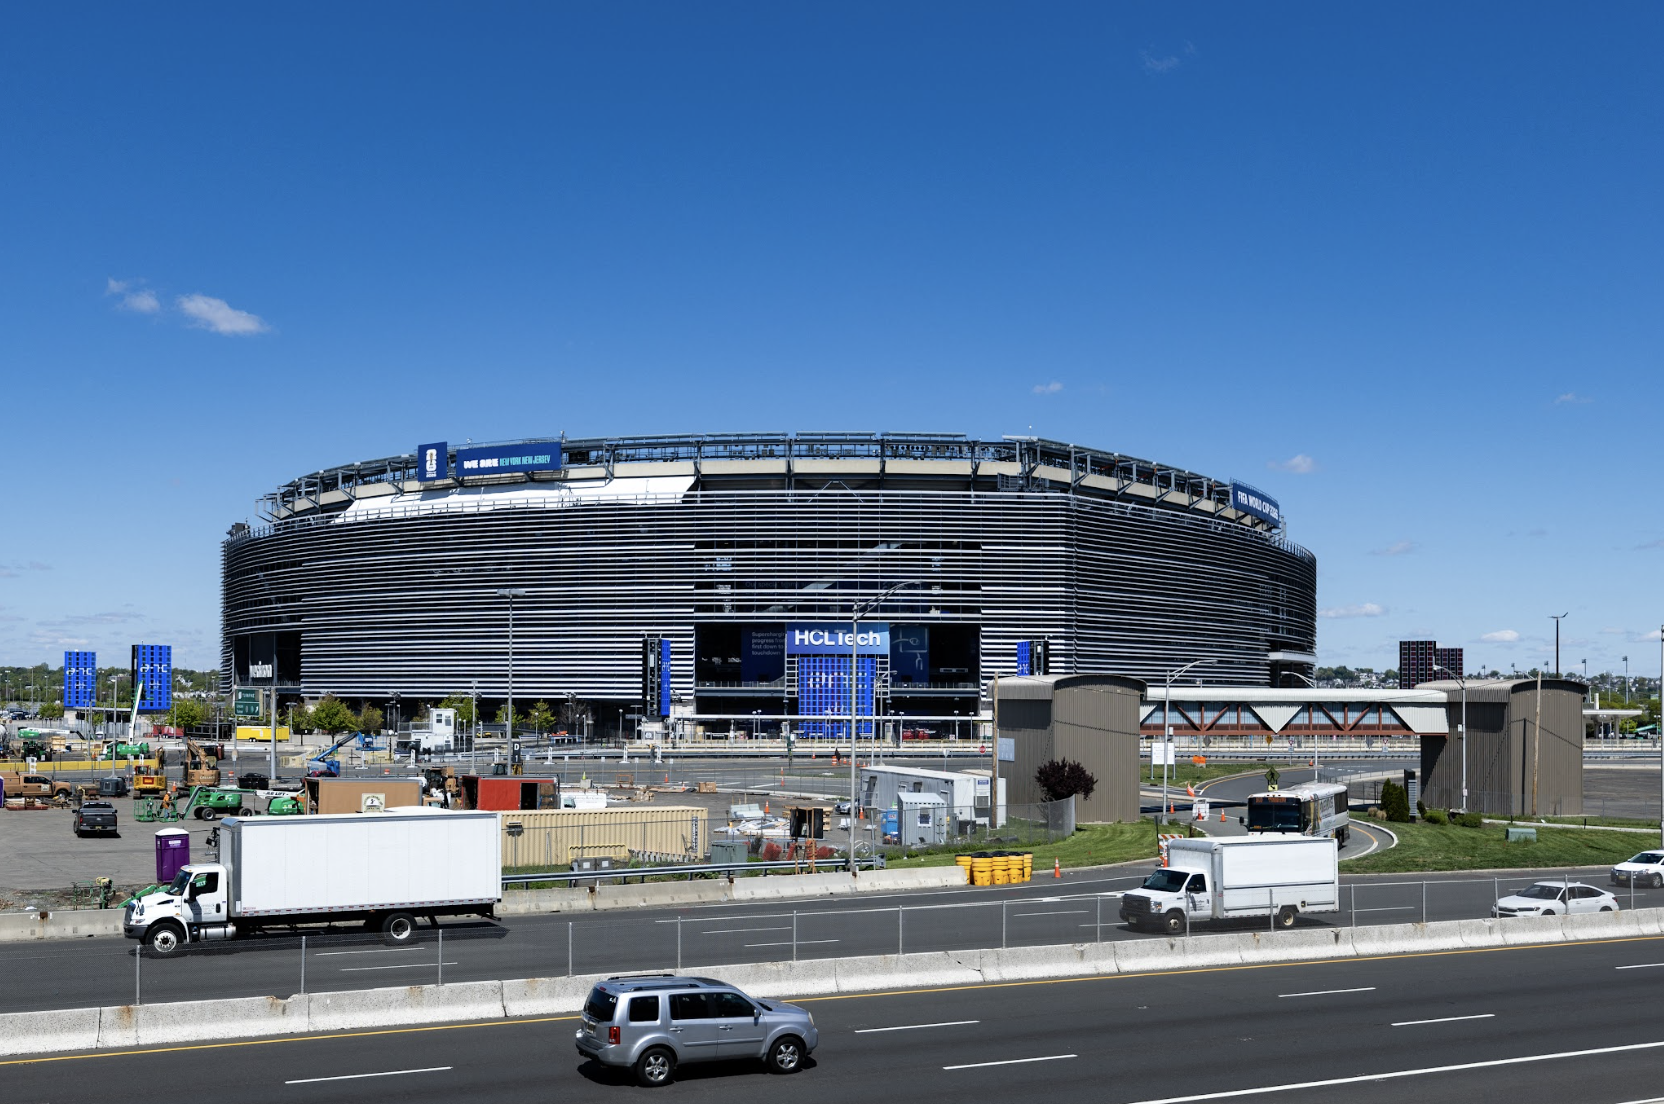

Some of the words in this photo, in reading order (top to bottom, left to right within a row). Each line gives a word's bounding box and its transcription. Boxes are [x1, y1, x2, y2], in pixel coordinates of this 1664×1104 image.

[463, 460, 478, 469] WE
[479, 458, 499, 468] ARE
[499, 457, 510, 467] NEW
[510, 456, 522, 466] YORK
[522, 456, 533, 465] NEW
[533, 455, 550, 464] JERSEY
[1238, 491, 1248, 505] FIFA
[1248, 495, 1261, 511] WORLD
[1262, 501, 1270, 514] CUP
[794, 629, 881, 646] HCLTech
[514, 743, 520, 751] D
